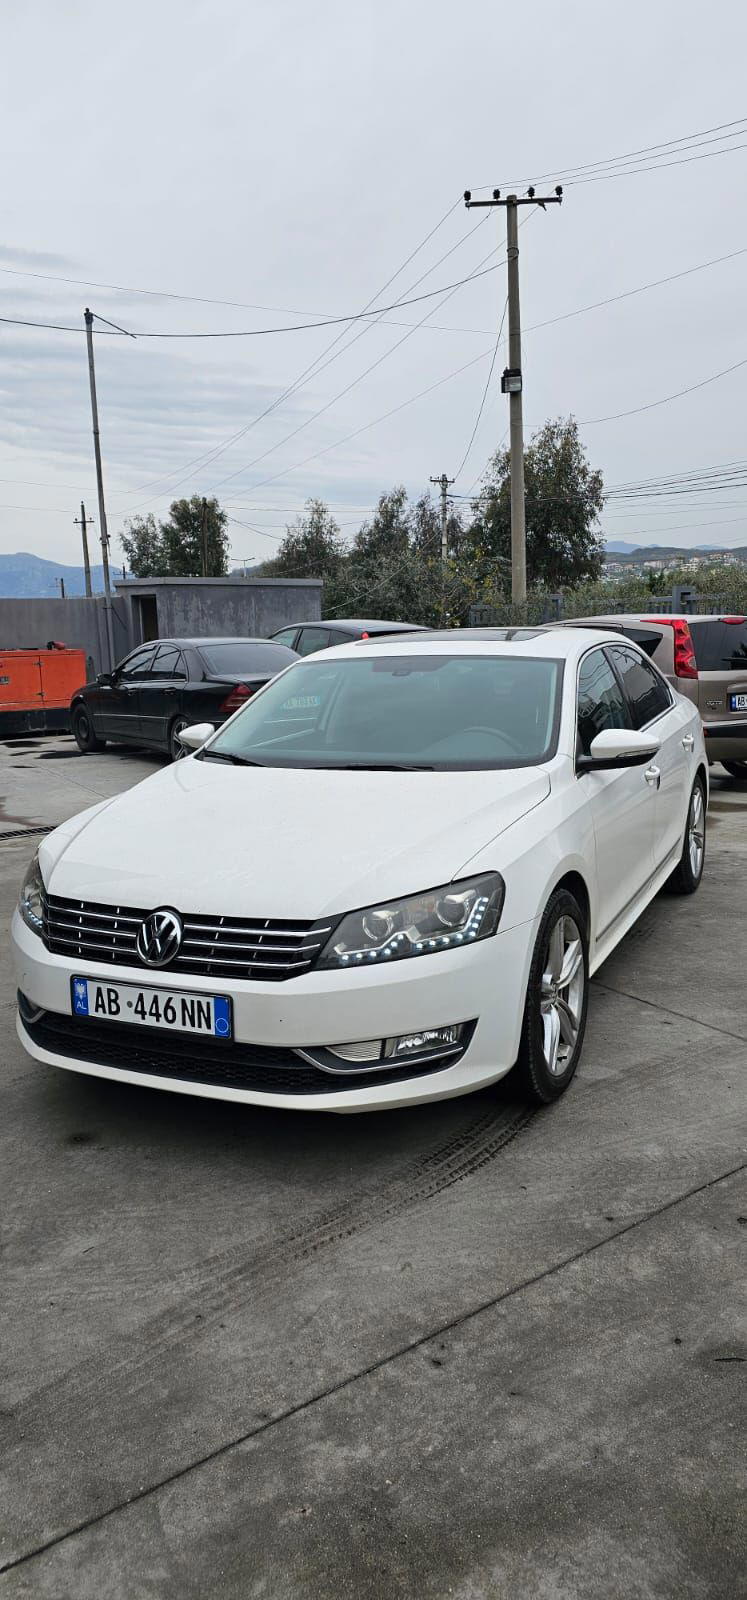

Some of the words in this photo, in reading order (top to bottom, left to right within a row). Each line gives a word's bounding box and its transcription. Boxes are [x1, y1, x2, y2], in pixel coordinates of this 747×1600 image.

[76, 1001, 87, 1010] AL
[95, 986, 121, 1016] AB
[134, 992, 177, 1024] 446
[181, 998, 212, 1030] NN
